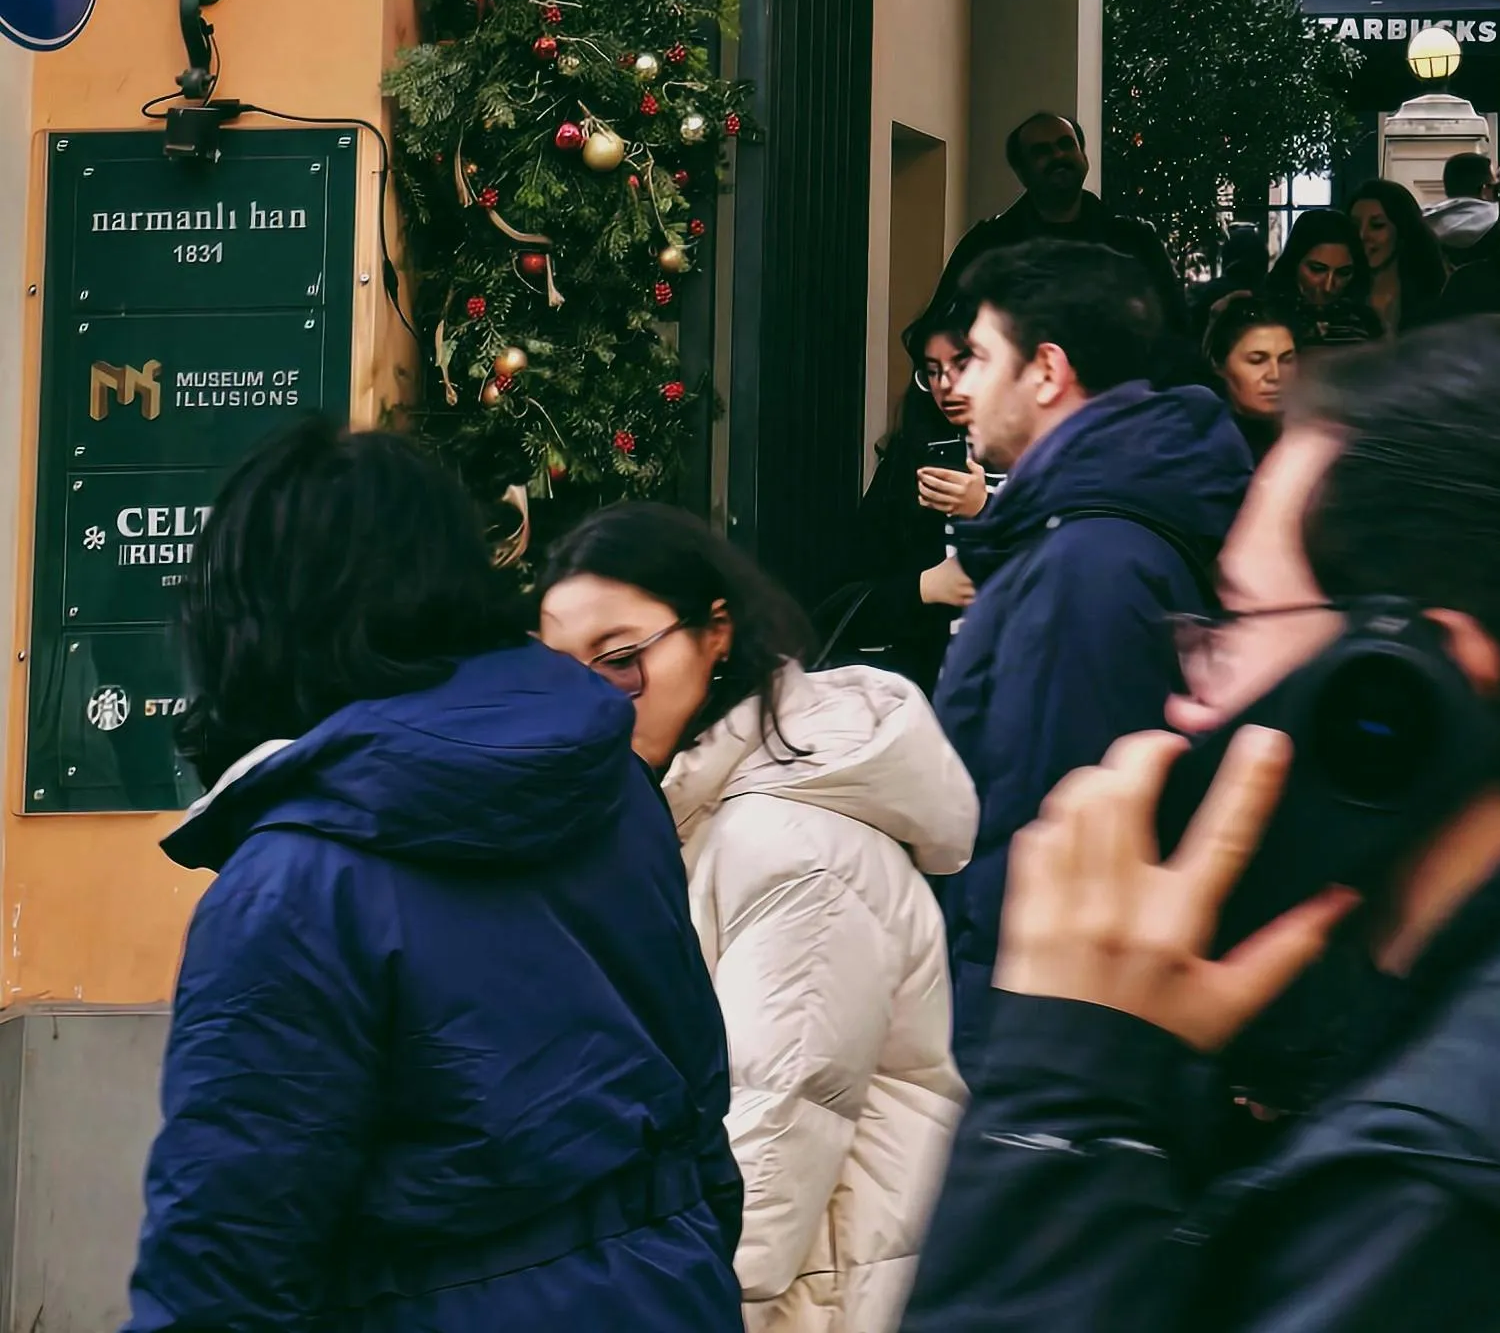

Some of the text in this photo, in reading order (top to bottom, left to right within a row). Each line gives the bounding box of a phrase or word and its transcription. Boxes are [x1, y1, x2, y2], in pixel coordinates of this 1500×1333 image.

[91, 200, 307, 232] narmanlı han
[172, 241, 224, 264] 1831
[175, 369, 300, 388] MUSEUM OF
[175, 390, 299, 408] ILLUSIONS
